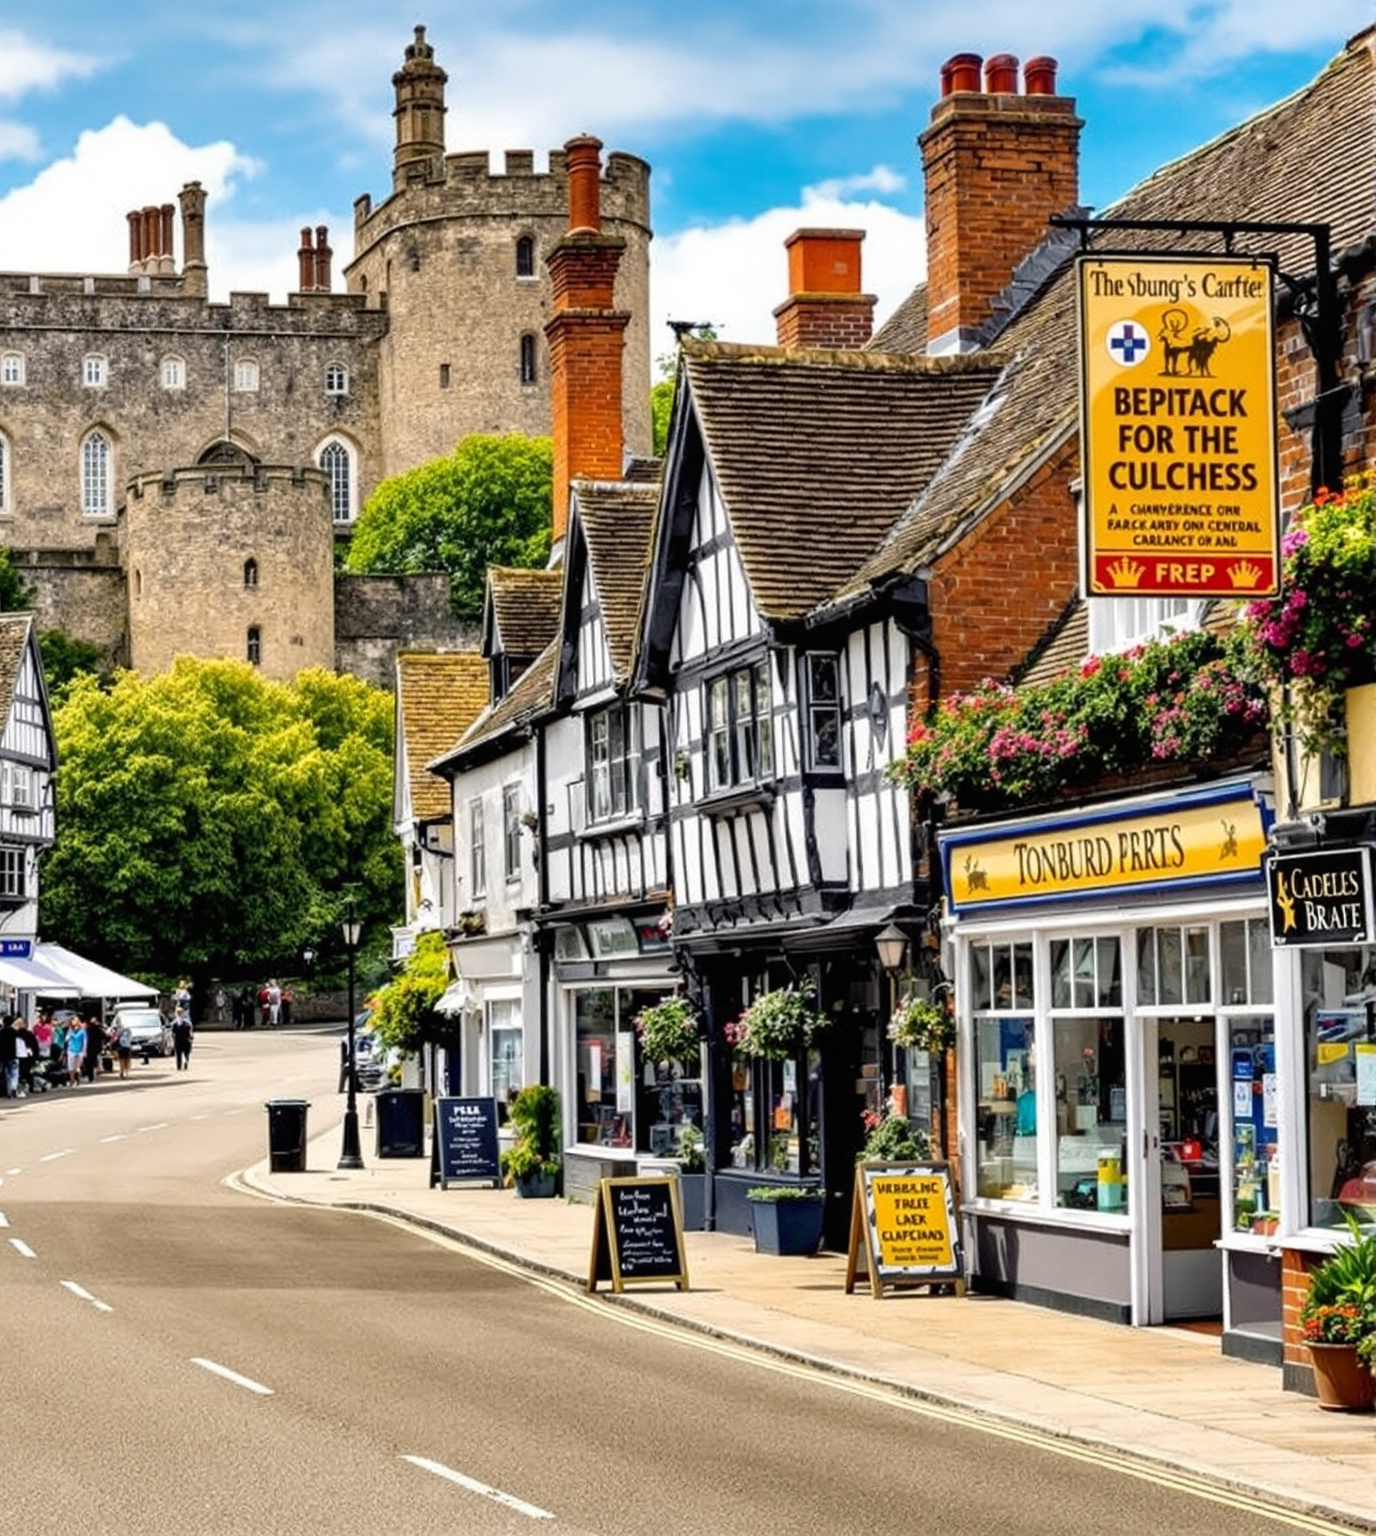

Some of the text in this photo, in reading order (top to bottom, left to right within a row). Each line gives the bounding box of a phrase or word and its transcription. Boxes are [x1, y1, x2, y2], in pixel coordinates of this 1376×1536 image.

[1090, 270, 1124, 297] The
[1114, 387, 1248, 417] BEPITACK
[1119, 424, 1239, 455] FOR THE
[1108, 461, 1259, 492] CULCHESS
[1108, 503, 1118, 515] A
[1155, 562, 1216, 584] FREP
[1012, 836, 1114, 886] TONBURD
